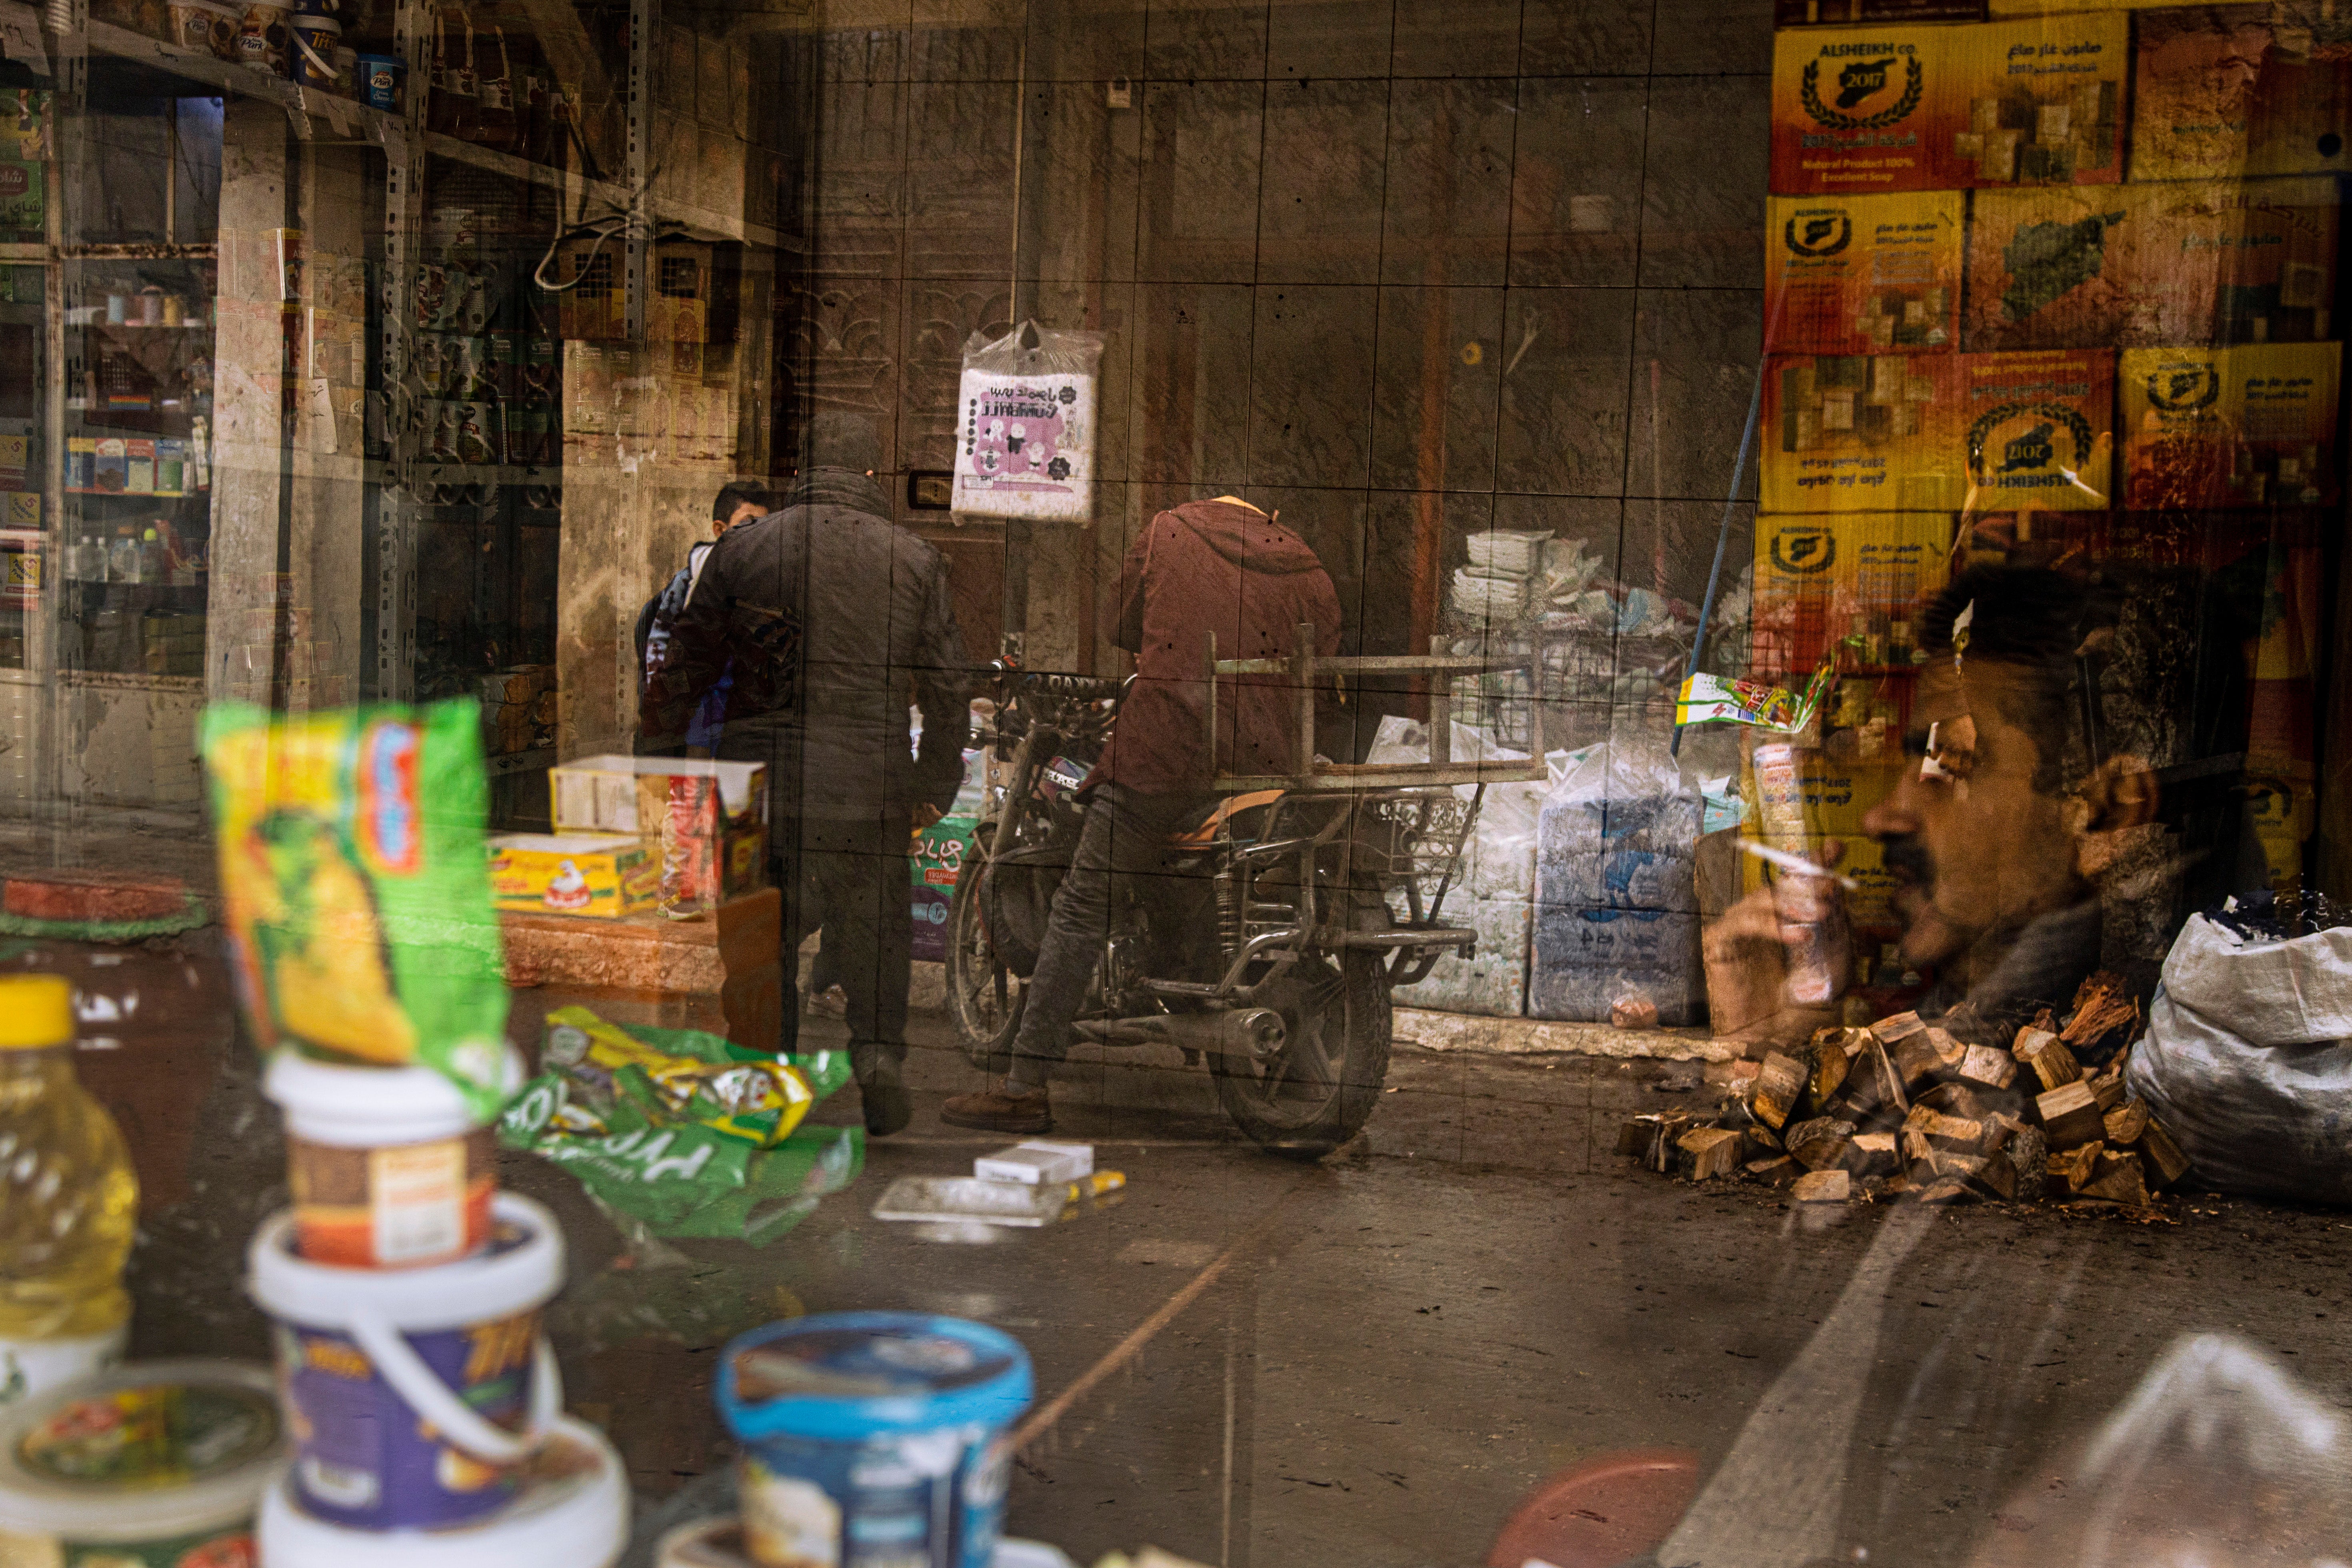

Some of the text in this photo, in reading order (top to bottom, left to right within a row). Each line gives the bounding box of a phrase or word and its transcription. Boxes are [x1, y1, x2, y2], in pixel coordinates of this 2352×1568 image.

[240, 38, 263, 50] Park
[1820, 43, 1894, 57] ALSHEIKH
[1845, 73, 1884, 88] 2017
[1879, 131, 1917, 149] شركة
[1802, 158, 1840, 170] Natural
[1842, 158, 1883, 168] Product
[1821, 171, 1866, 183] Excellent
[11, 440, 23, 452] 5
[2008, 445, 2045, 459] 2017
[24, 497, 37, 508] 5
